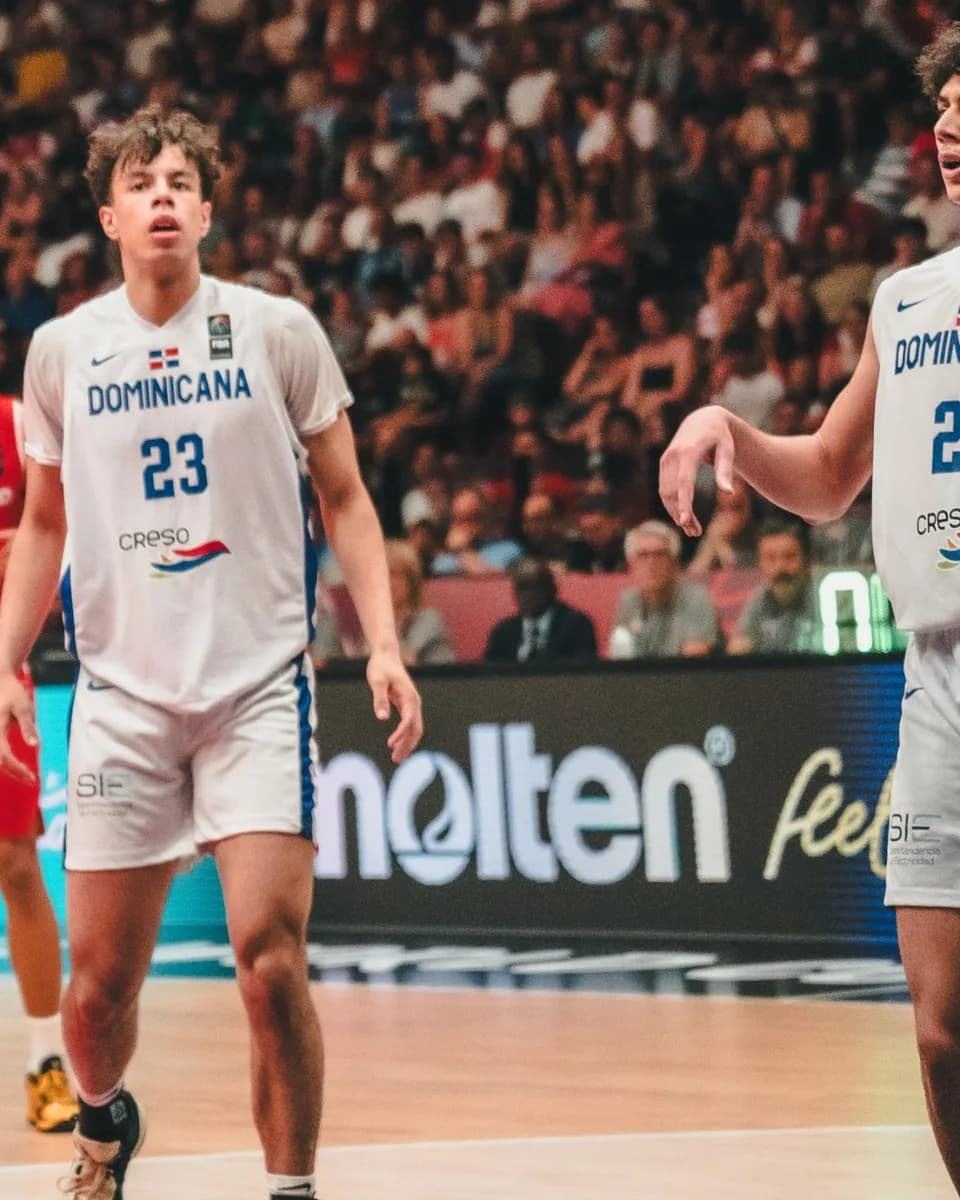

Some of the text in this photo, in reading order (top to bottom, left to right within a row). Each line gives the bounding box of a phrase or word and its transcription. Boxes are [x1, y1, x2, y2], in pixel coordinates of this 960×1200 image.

[894, 329, 960, 375] DOMIN
[88, 367, 252, 416] DOMINICANA
[141, 432, 209, 500] 23
[932, 400, 960, 474] 2
